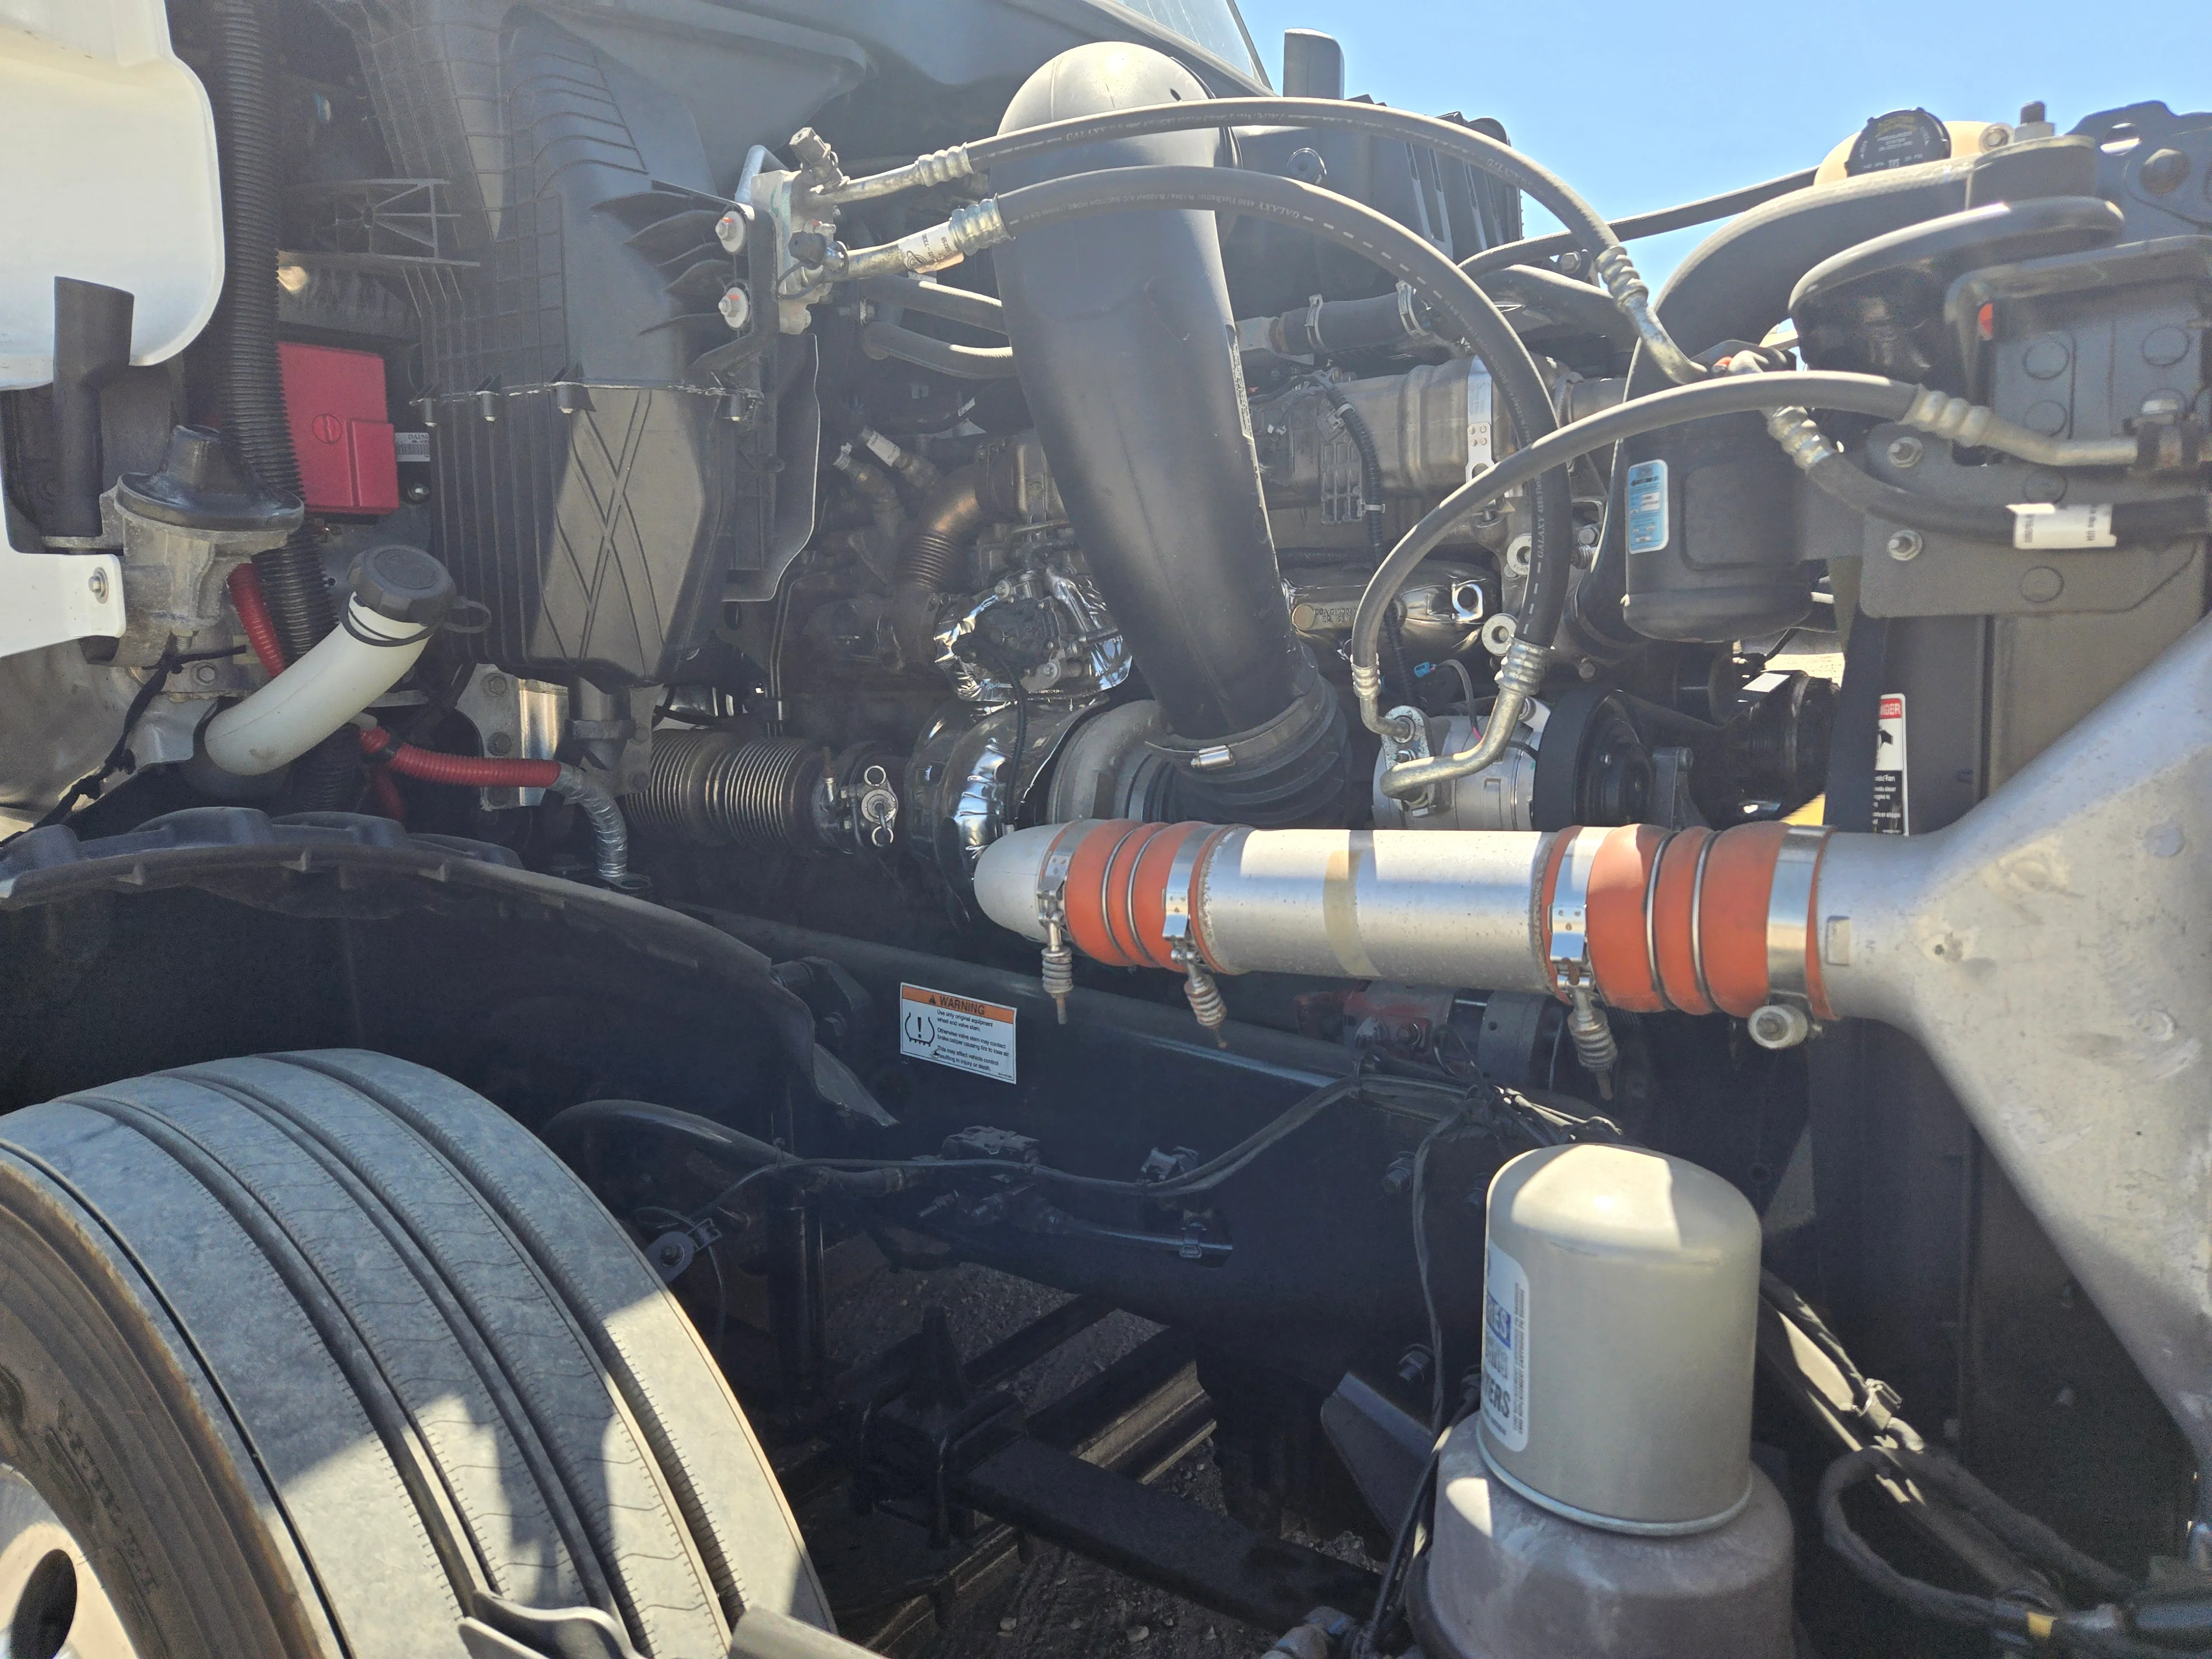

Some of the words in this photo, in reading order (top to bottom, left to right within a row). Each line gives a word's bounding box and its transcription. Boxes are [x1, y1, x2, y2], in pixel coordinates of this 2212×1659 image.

[1256, 201, 1300, 219] GALAXY
[940, 995, 984, 1015] WARNING
[956, 1014, 971, 1022] original
[971, 1018, 993, 1027] equipment
[937, 1027, 957, 1037] Otherwise
[990, 1040, 1006, 1048] contact
[950, 1037, 963, 1046] caliper
[964, 1041, 980, 1050] causing
[961, 1058, 972, 1067] injury
[984, 1057, 998, 1065] control
